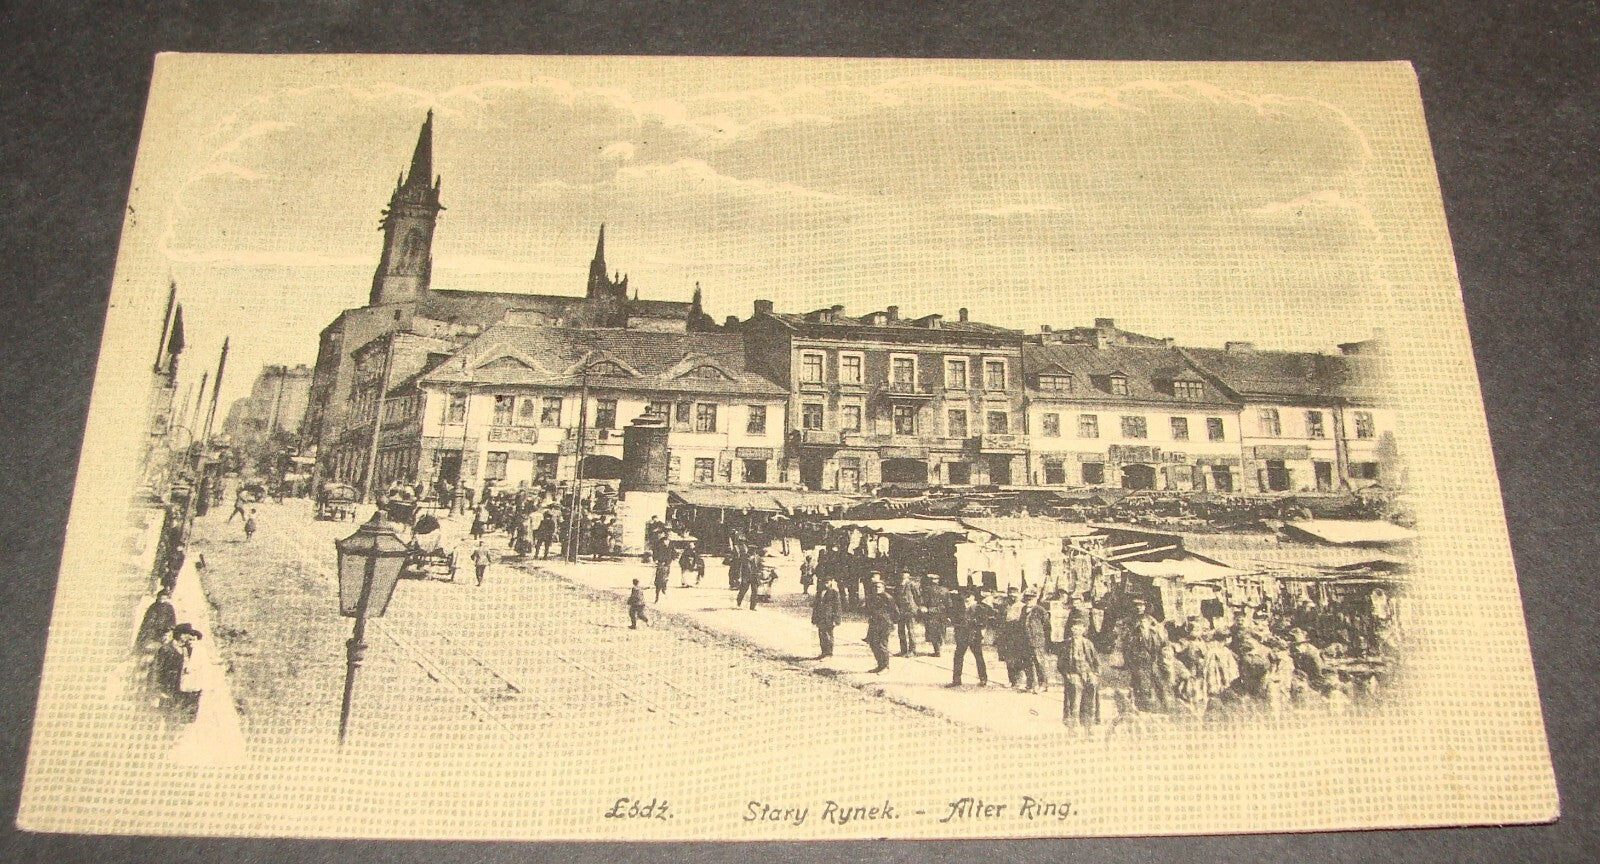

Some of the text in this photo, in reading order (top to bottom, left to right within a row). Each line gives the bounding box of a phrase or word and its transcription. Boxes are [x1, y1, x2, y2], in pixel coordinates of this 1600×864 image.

[742, 800, 809, 826] Stary
[820, 799, 901, 825] Rynek.
[939, 797, 1008, 823] Alter
[1019, 795, 1079, 821] Ring.
